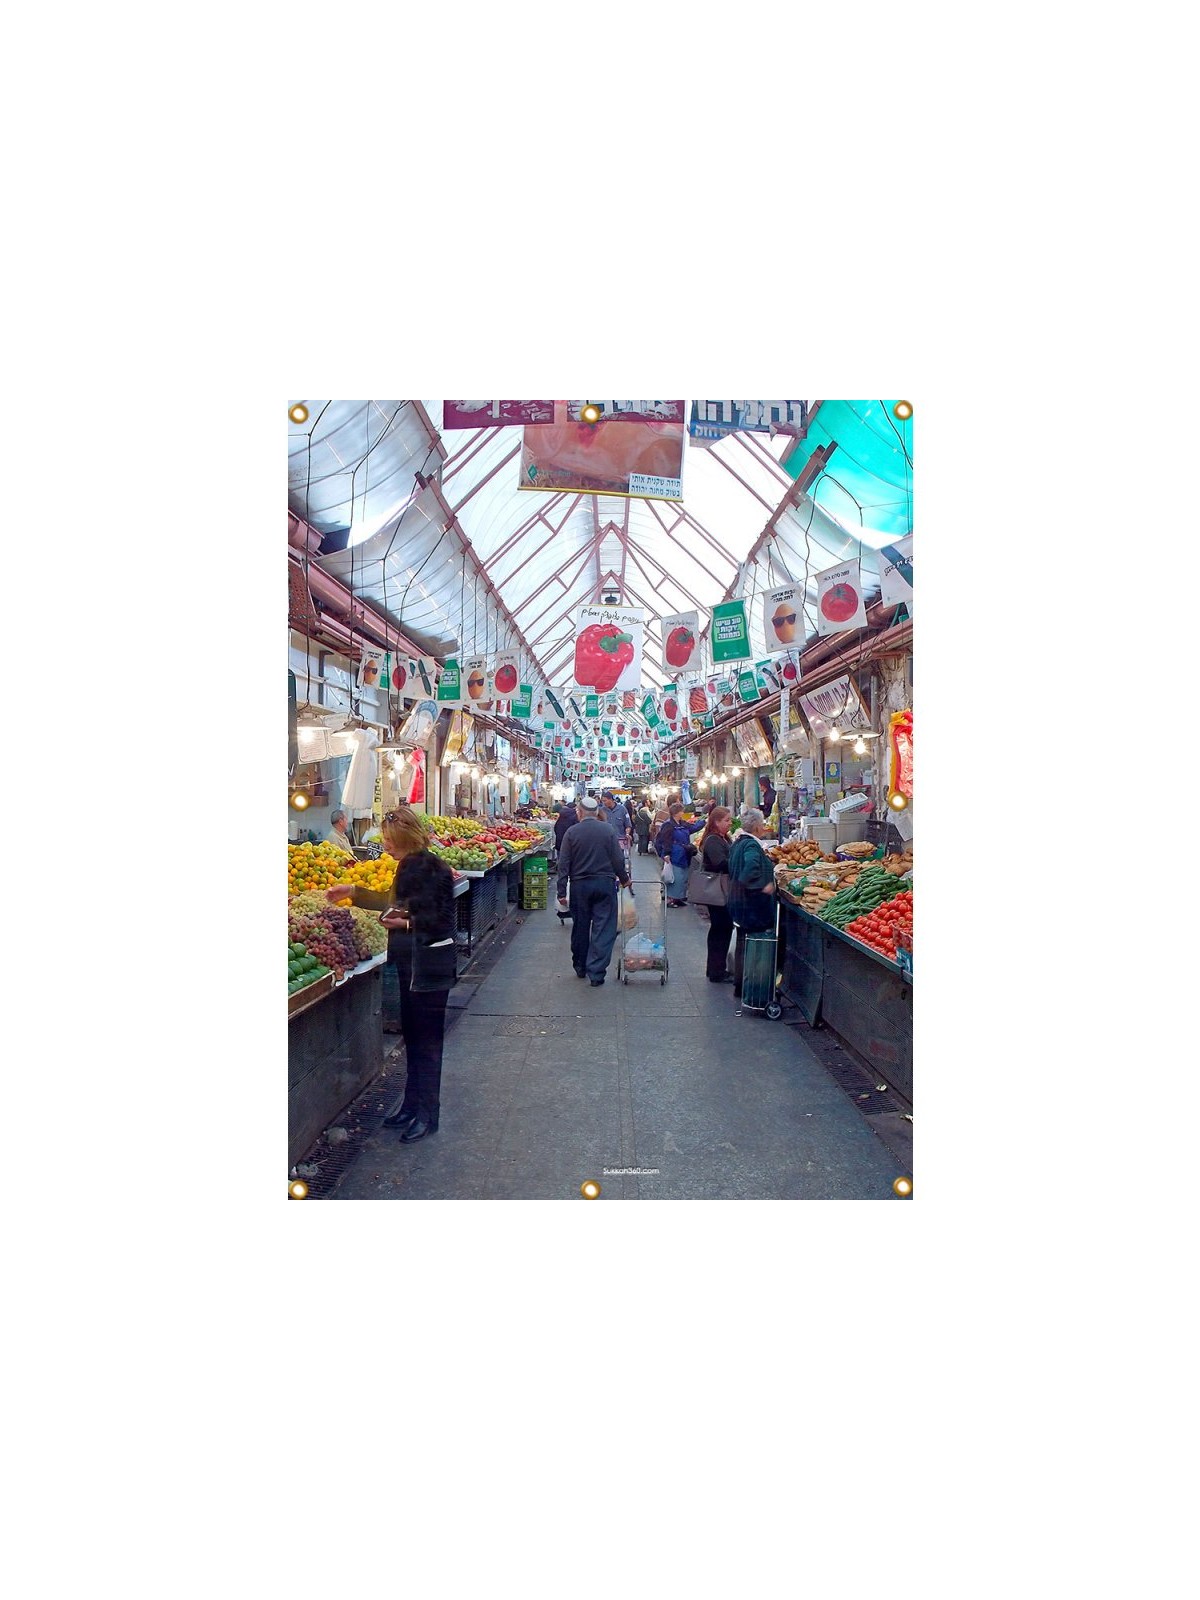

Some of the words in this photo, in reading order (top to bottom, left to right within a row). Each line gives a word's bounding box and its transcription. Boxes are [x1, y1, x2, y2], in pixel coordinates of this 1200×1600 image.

[631, 475, 646, 483] אותי
[647, 477, 665, 486] שקנית
[666, 479, 681, 488] תודה
[631, 485, 648, 493] יהודה
[649, 487, 664, 495] מחנה
[665, 489, 680, 497] בשוק
